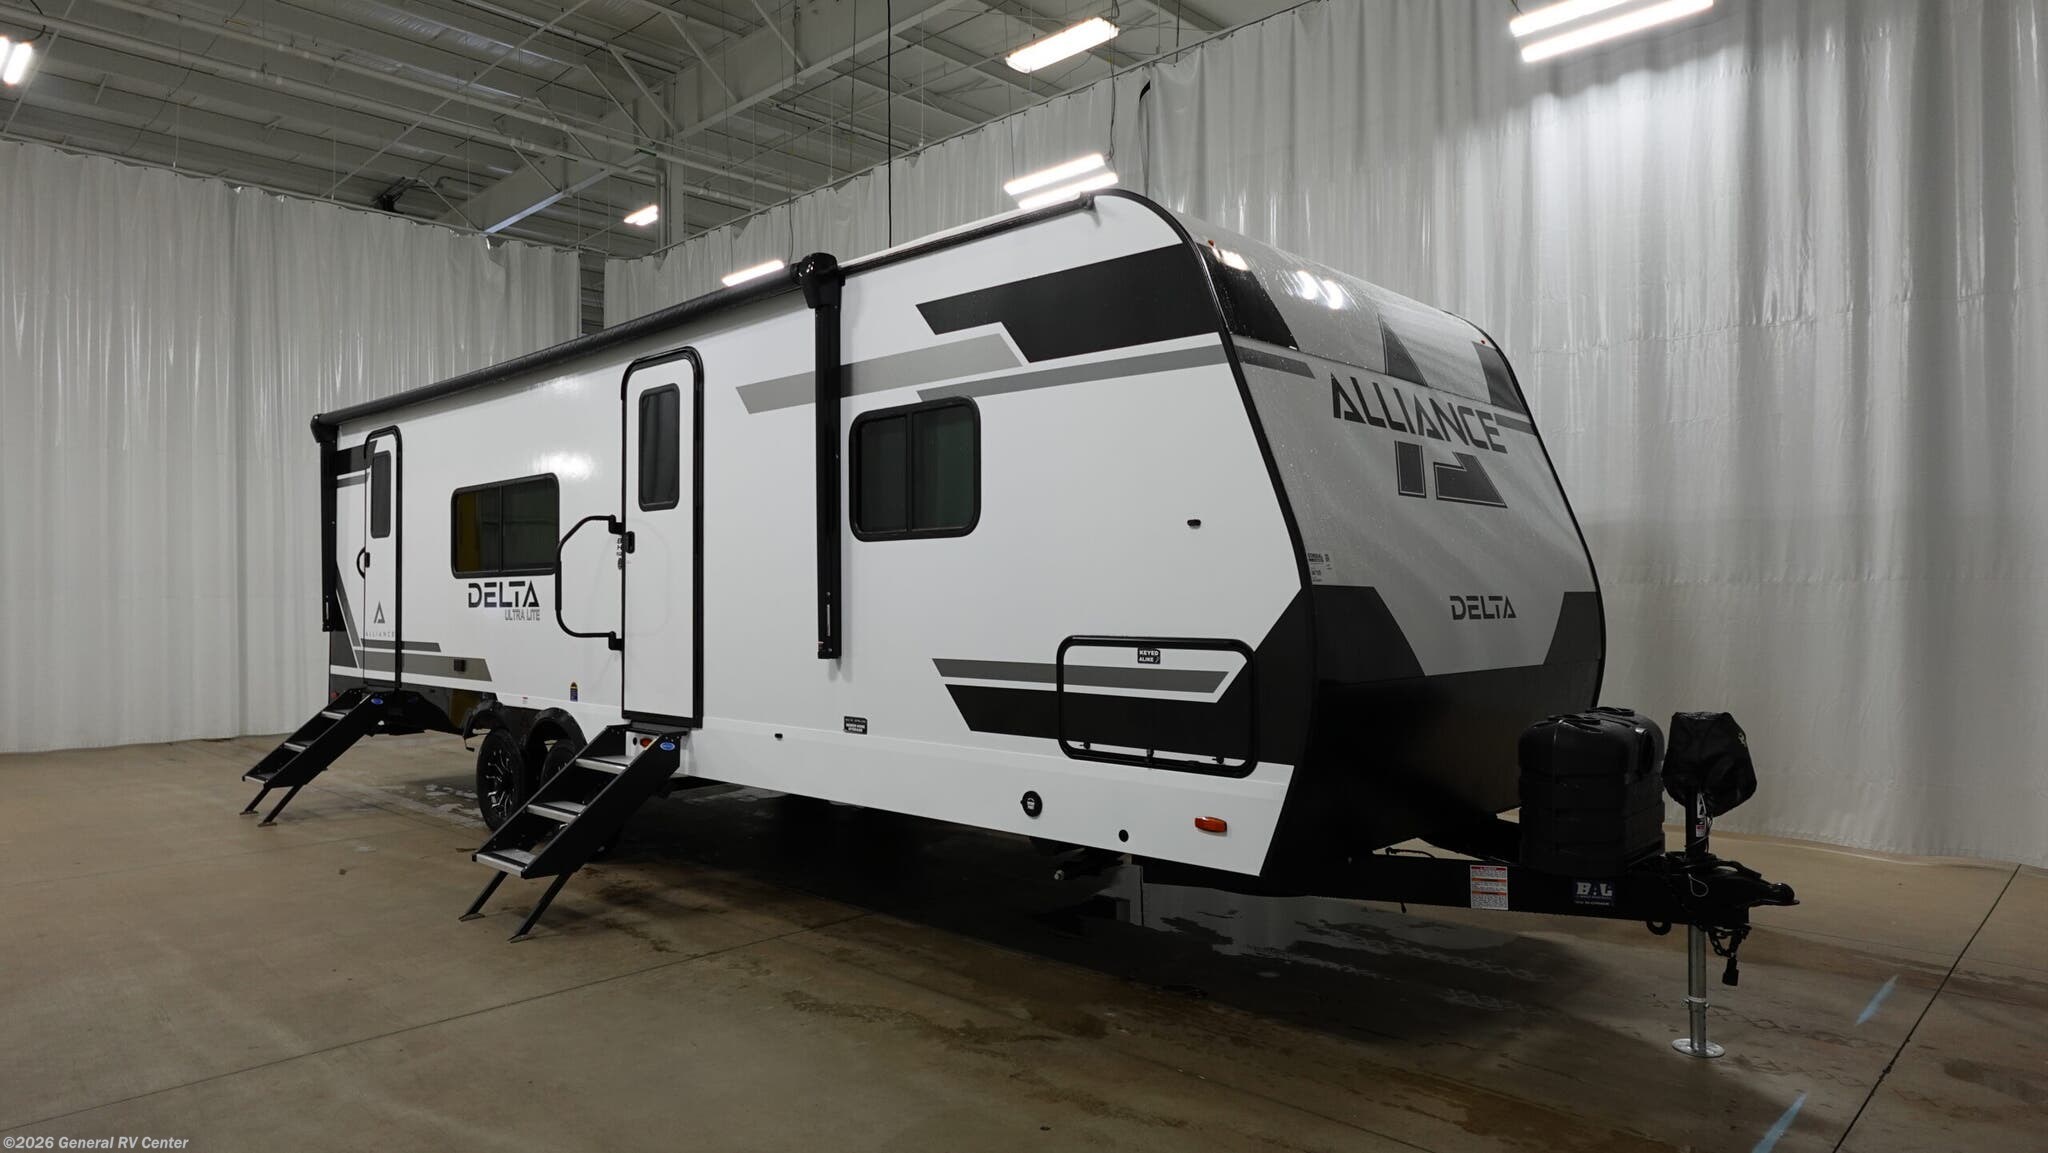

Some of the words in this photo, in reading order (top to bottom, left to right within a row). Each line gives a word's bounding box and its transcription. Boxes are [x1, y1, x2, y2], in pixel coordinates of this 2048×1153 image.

[1331, 373, 1508, 453] ALLIANCE
[468, 580, 540, 608] DELTA
[505, 609, 525, 621] ULTRA
[527, 609, 541, 621] LITE
[1450, 596, 1517, 620] DELTA
